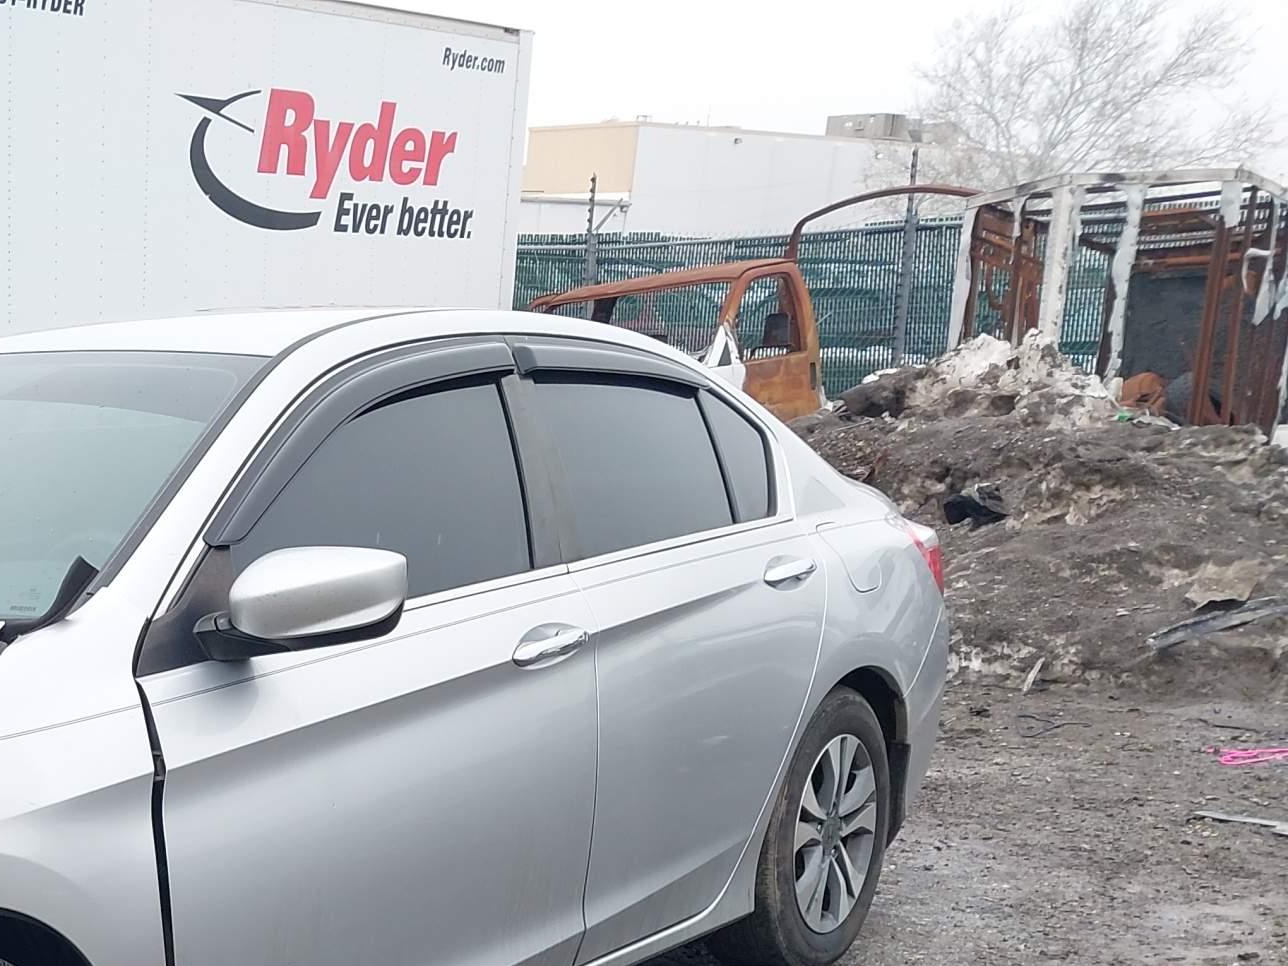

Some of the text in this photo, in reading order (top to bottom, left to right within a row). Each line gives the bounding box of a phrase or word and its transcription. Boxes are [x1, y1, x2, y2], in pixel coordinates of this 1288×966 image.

[442, 46, 506, 74] Ryder.com
[257, 88, 458, 199] Ryder
[333, 192, 474, 239] Ever better.
